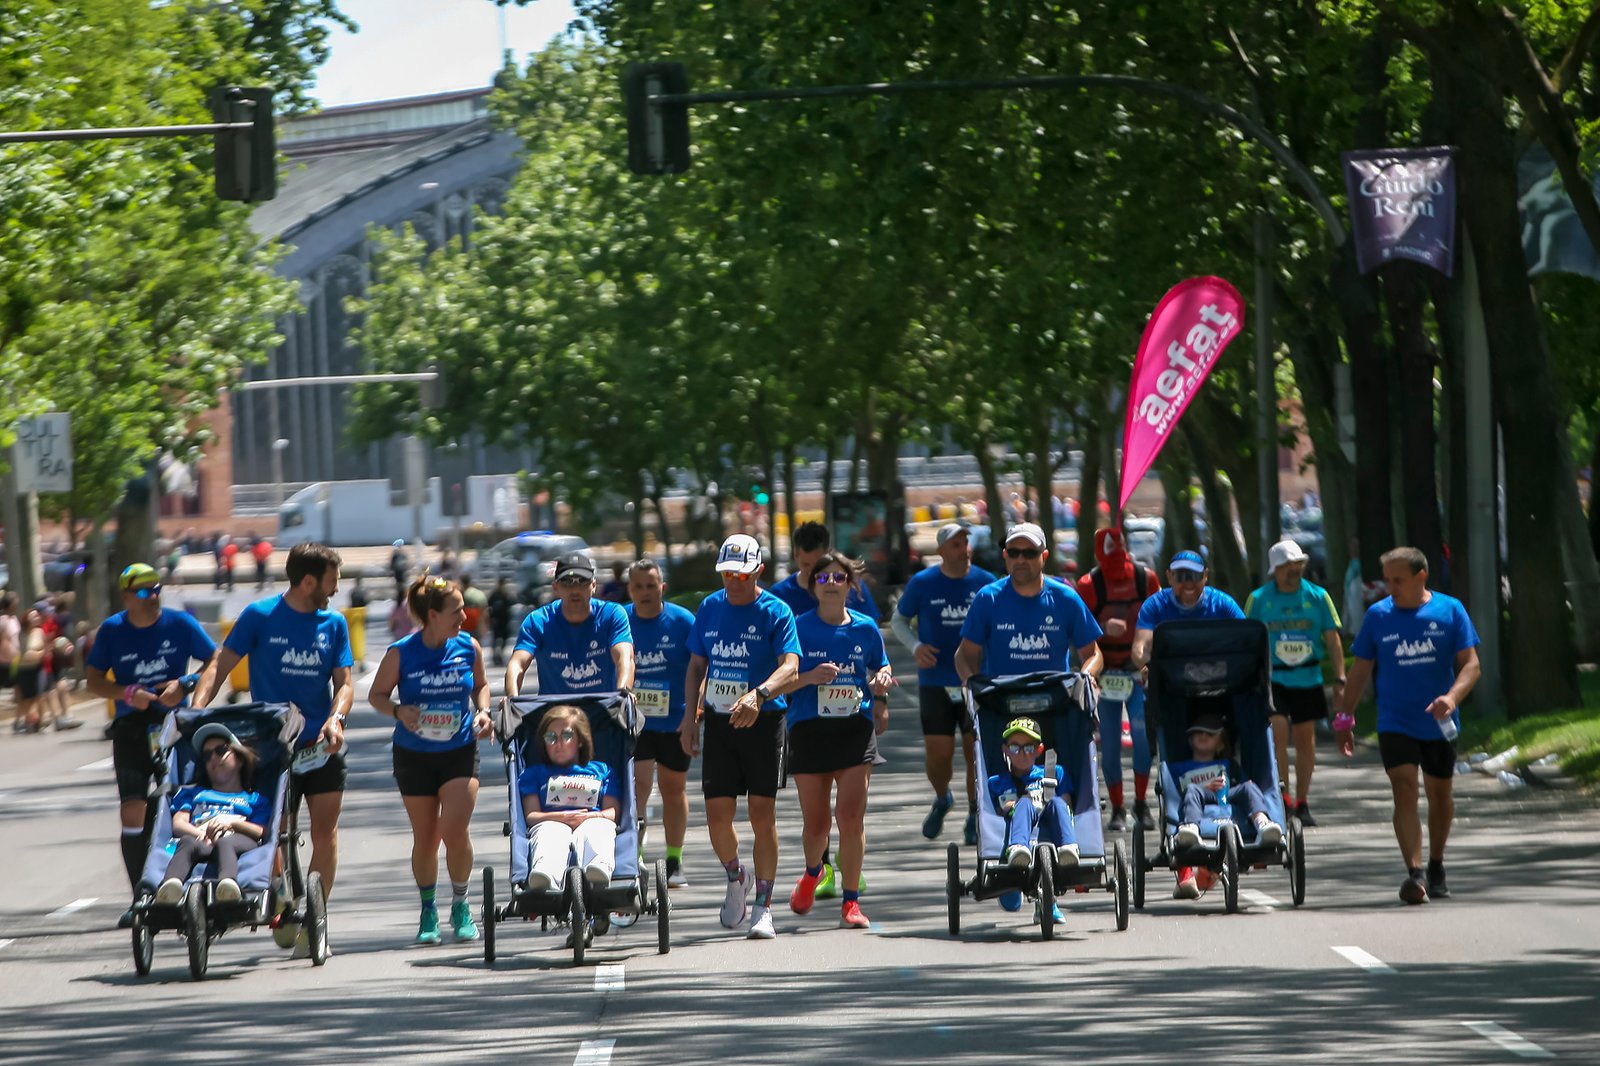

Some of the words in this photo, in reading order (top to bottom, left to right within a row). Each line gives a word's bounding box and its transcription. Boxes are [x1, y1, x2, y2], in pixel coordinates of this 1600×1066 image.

[1360, 174, 1444, 196] Guido
[1374, 197, 1434, 218] Reni
[1140, 304, 1232, 426] aefat
[714, 683, 737, 696] 2974
[828, 688, 853, 700] 7792
[636, 692, 658, 703] 9198
[420, 714, 452, 725] 29839
